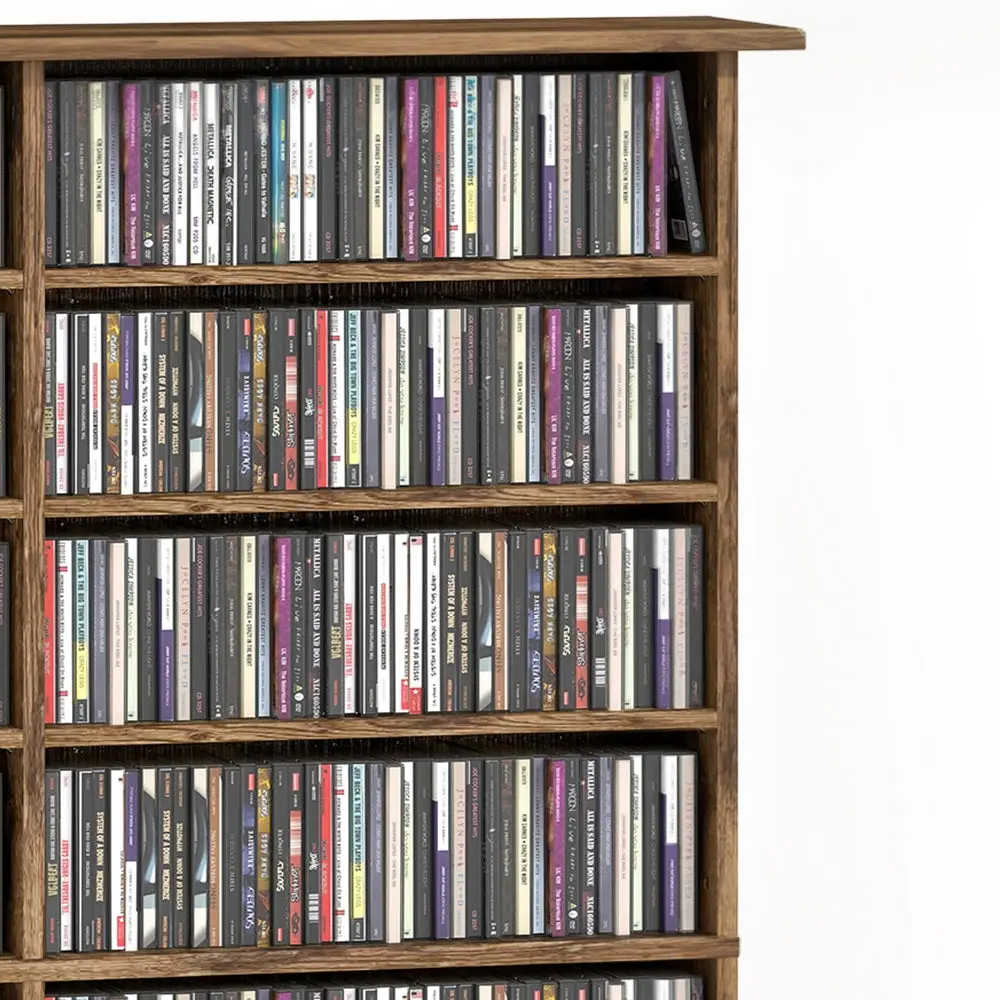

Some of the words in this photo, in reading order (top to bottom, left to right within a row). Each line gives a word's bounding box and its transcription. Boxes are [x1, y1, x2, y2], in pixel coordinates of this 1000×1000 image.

[162, 150, 169, 158] IS
[582, 309, 590, 348] METALLICA
[582, 358, 590, 371] ALL
[350, 372, 358, 389] TOWN
[582, 382, 590, 398] SAID
[582, 400, 590, 415] AND
[582, 416, 590, 435] DONE
[587, 824, 594, 832] IS
